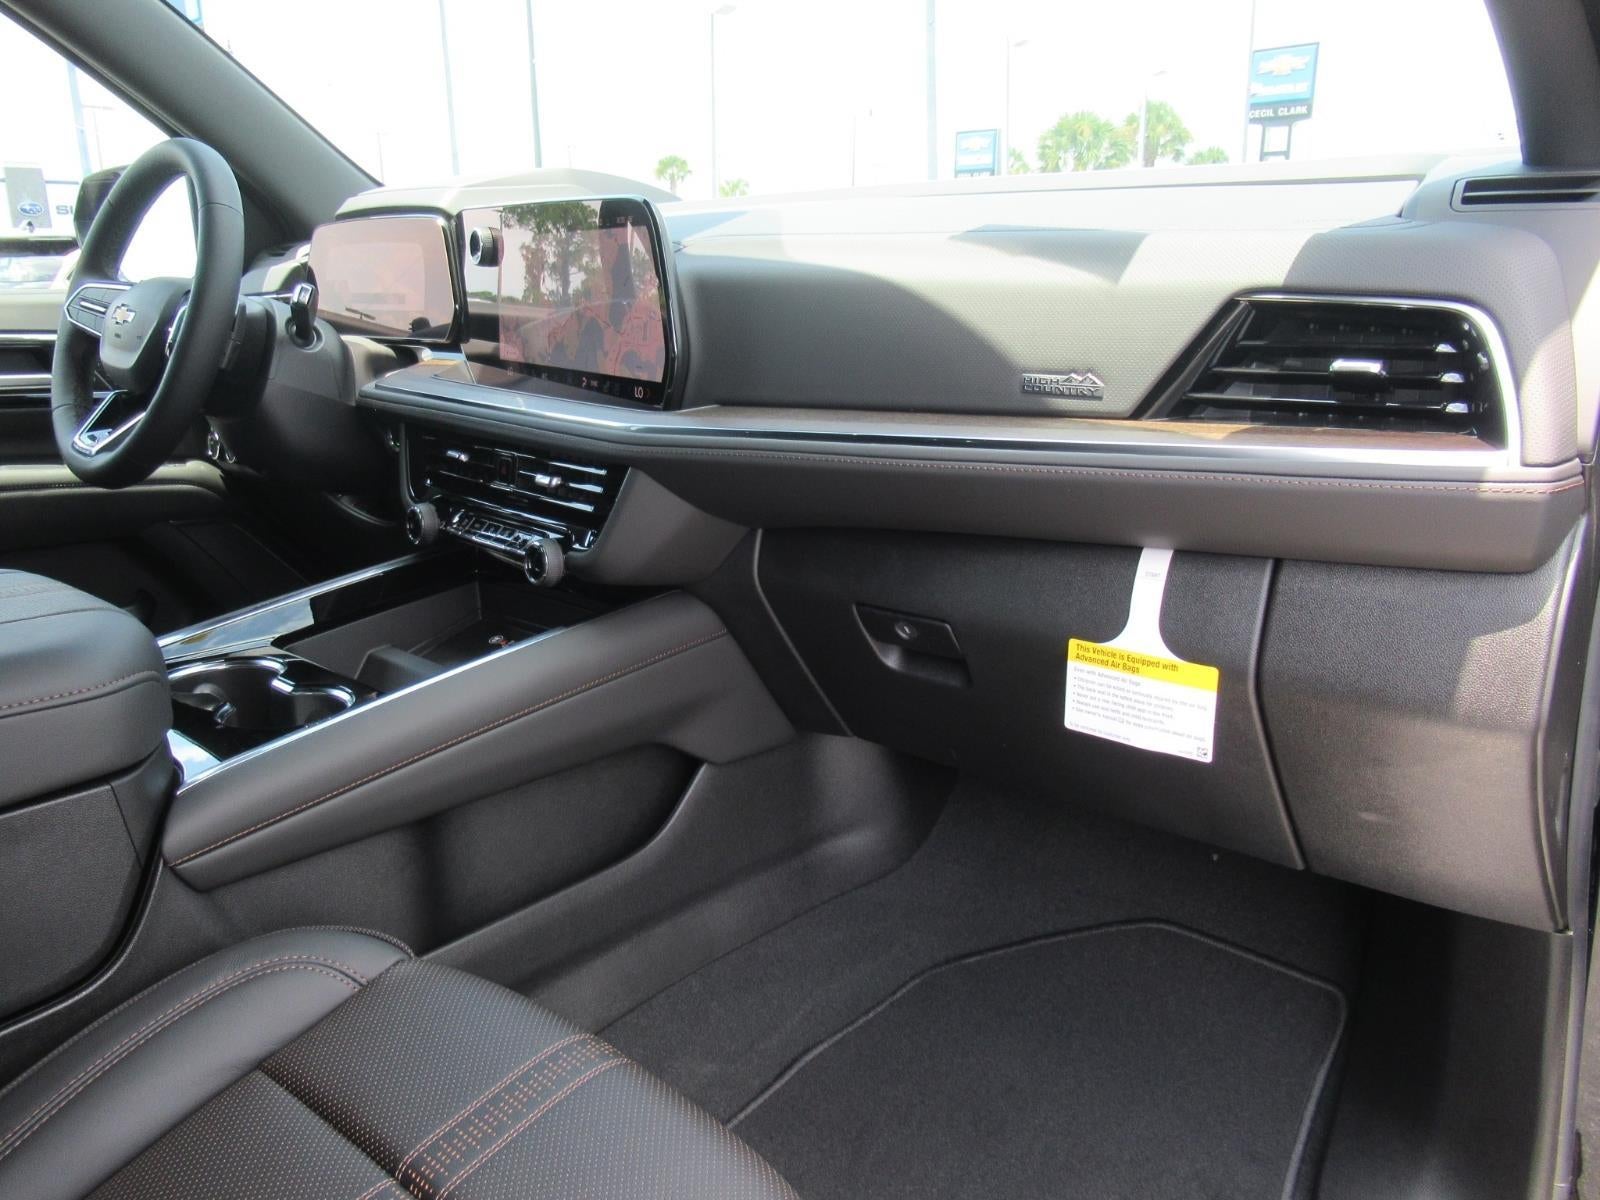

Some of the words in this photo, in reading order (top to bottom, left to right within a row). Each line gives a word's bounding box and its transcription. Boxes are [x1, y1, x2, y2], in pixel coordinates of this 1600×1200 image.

[1249, 109, 1274, 119] CECIL
[1278, 105, 1308, 116] CLARK
[1023, 384, 1102, 397] COUNTRY
[1075, 653, 1109, 667] Advanced
[1111, 660, 1120, 669] Air
[1122, 662, 1140, 674] Bags
[1076, 643, 1090, 653] This
[1092, 647, 1117, 659] Vehicle
[1119, 651, 1125, 660] is
[1127, 654, 1160, 668] Equipped
[1162, 661, 1179, 672] with
